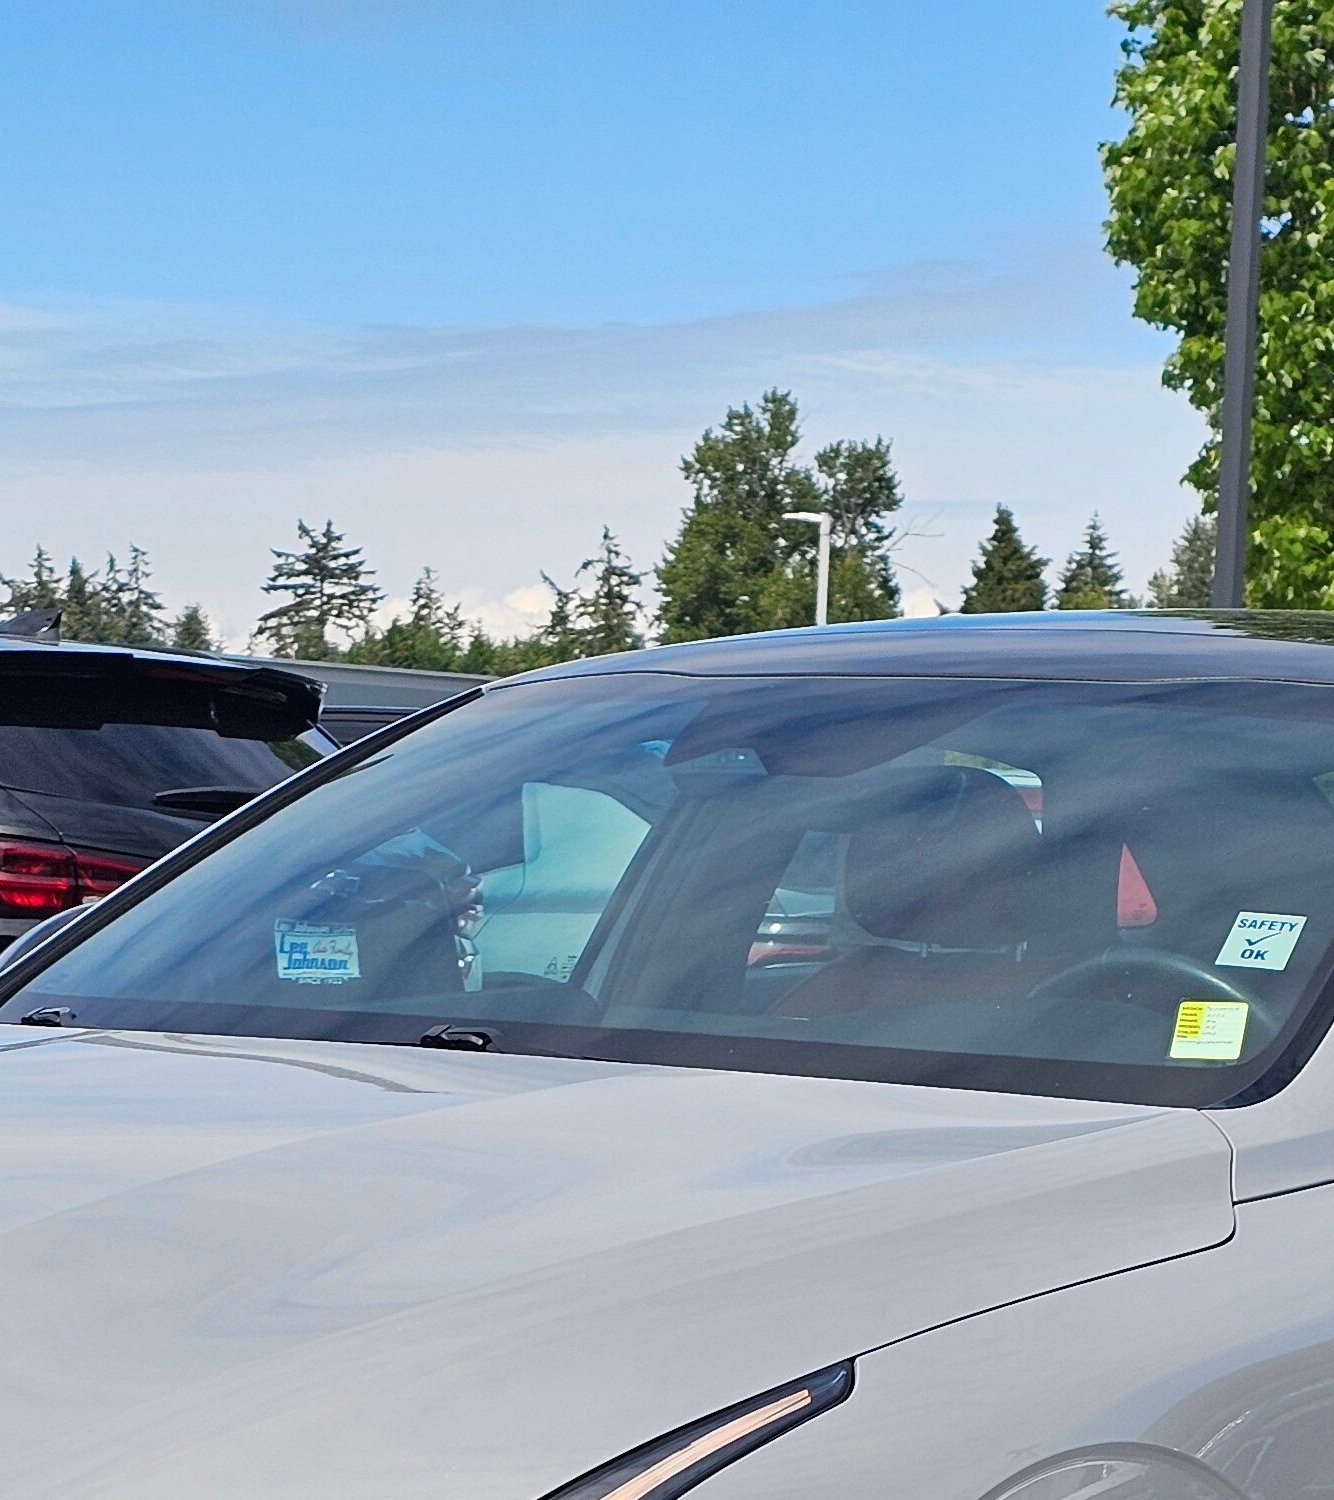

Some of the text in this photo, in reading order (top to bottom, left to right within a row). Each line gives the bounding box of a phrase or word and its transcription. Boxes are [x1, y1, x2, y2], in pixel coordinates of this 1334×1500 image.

[1237, 918, 1299, 933] SAFETY
[279, 933, 308, 953] Lee
[283, 952, 350, 970] Johnson
[1240, 948, 1269, 961] OK
